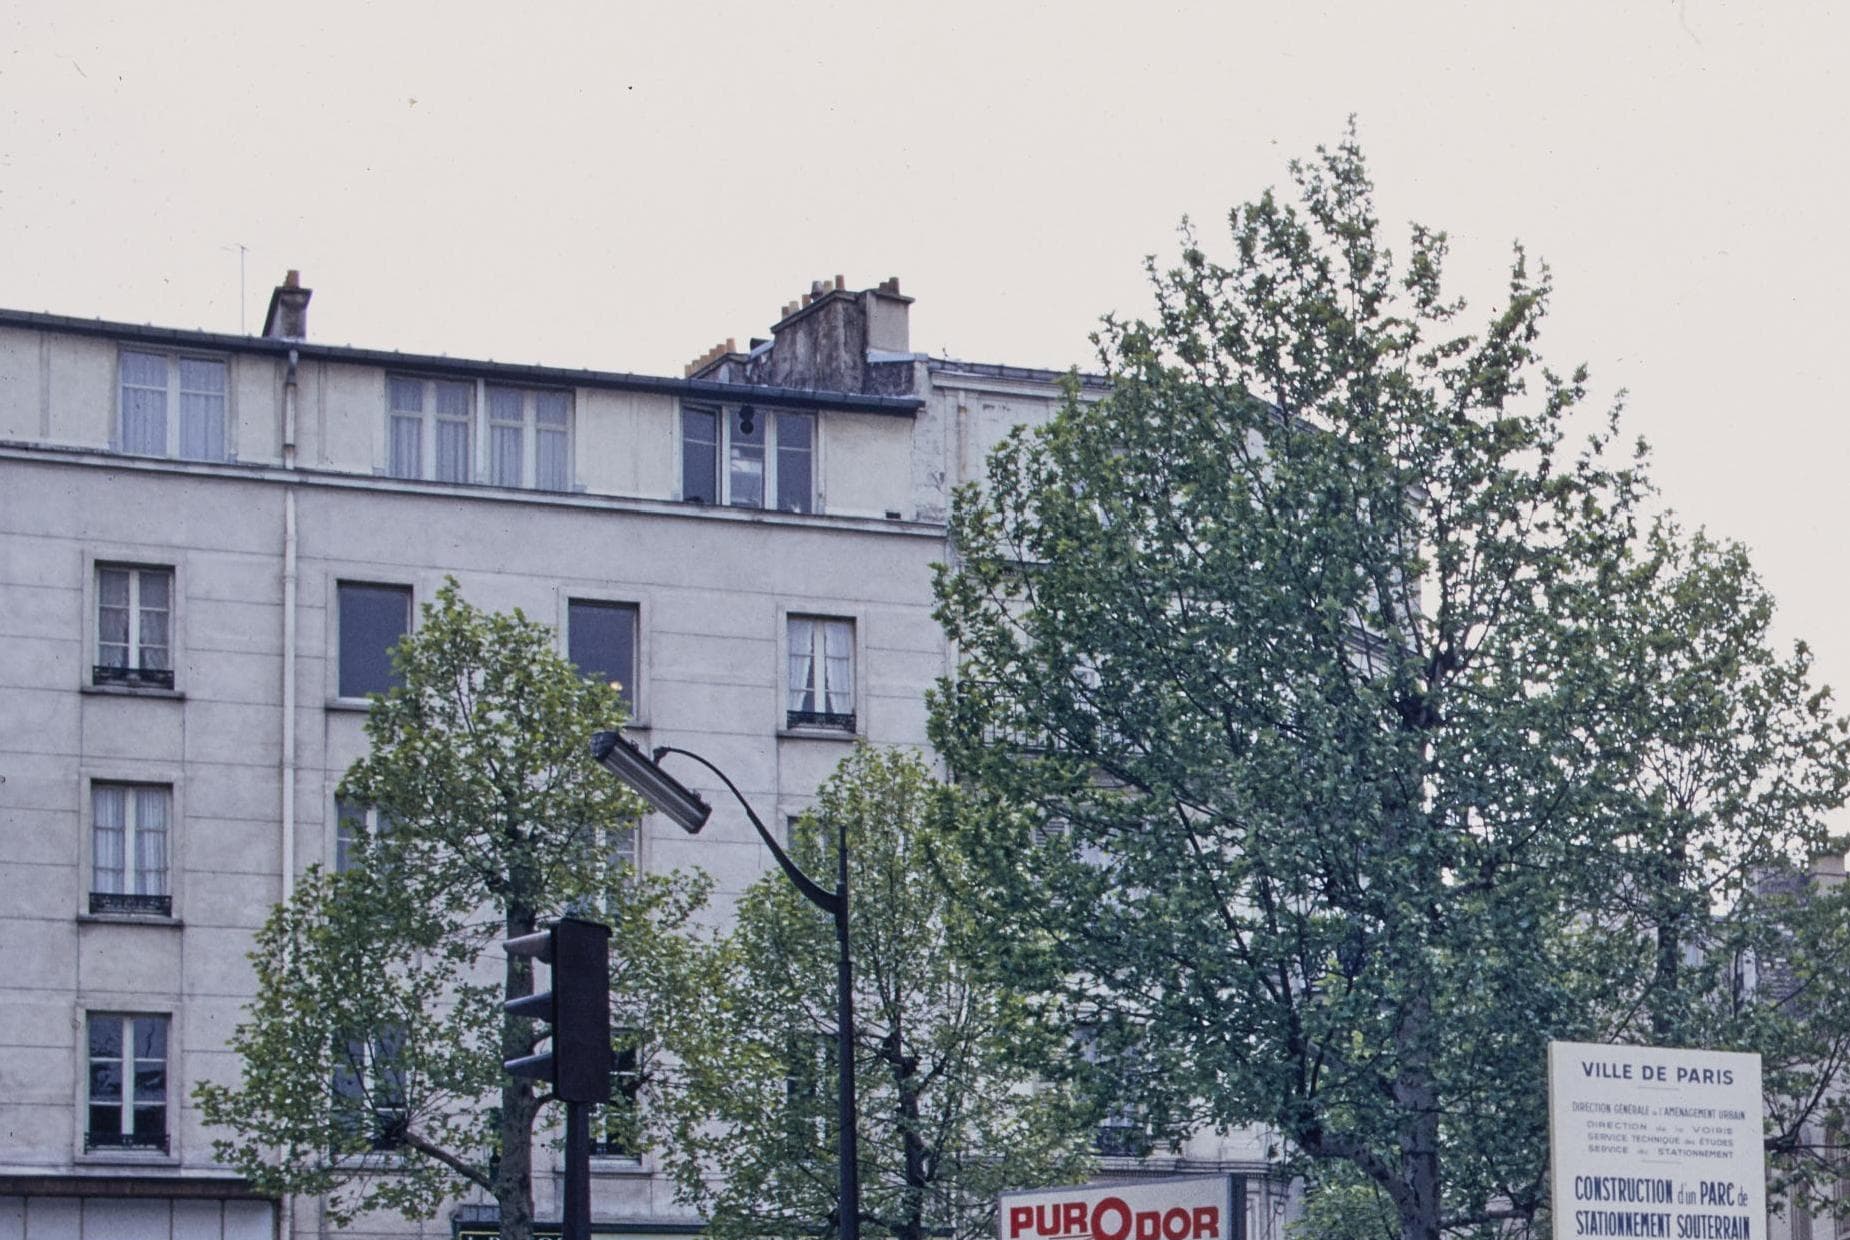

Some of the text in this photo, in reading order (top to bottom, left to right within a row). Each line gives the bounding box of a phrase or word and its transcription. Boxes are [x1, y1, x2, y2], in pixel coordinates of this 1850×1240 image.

[1582, 1061, 1734, 1085] VILLE DE PARIS
[1572, 1101, 1611, 1113] DIRECTION
[1587, 1120, 1647, 1131] DIRECTION
[1693, 1126, 1733, 1135] VOIRIE
[1587, 1132, 1628, 1142] SERVICE
[1632, 1134, 1680, 1145] TECHNIQUE
[1588, 1144, 1628, 1154] SERVICE
[1658, 1148, 1734, 1159] STATIONNEMENT
[1575, 1175, 1748, 1207] CONSTRUCTION d'un PARC de
[1575, 1210, 1750, 1240] STATIONNEMENT SOUTERRAIN
